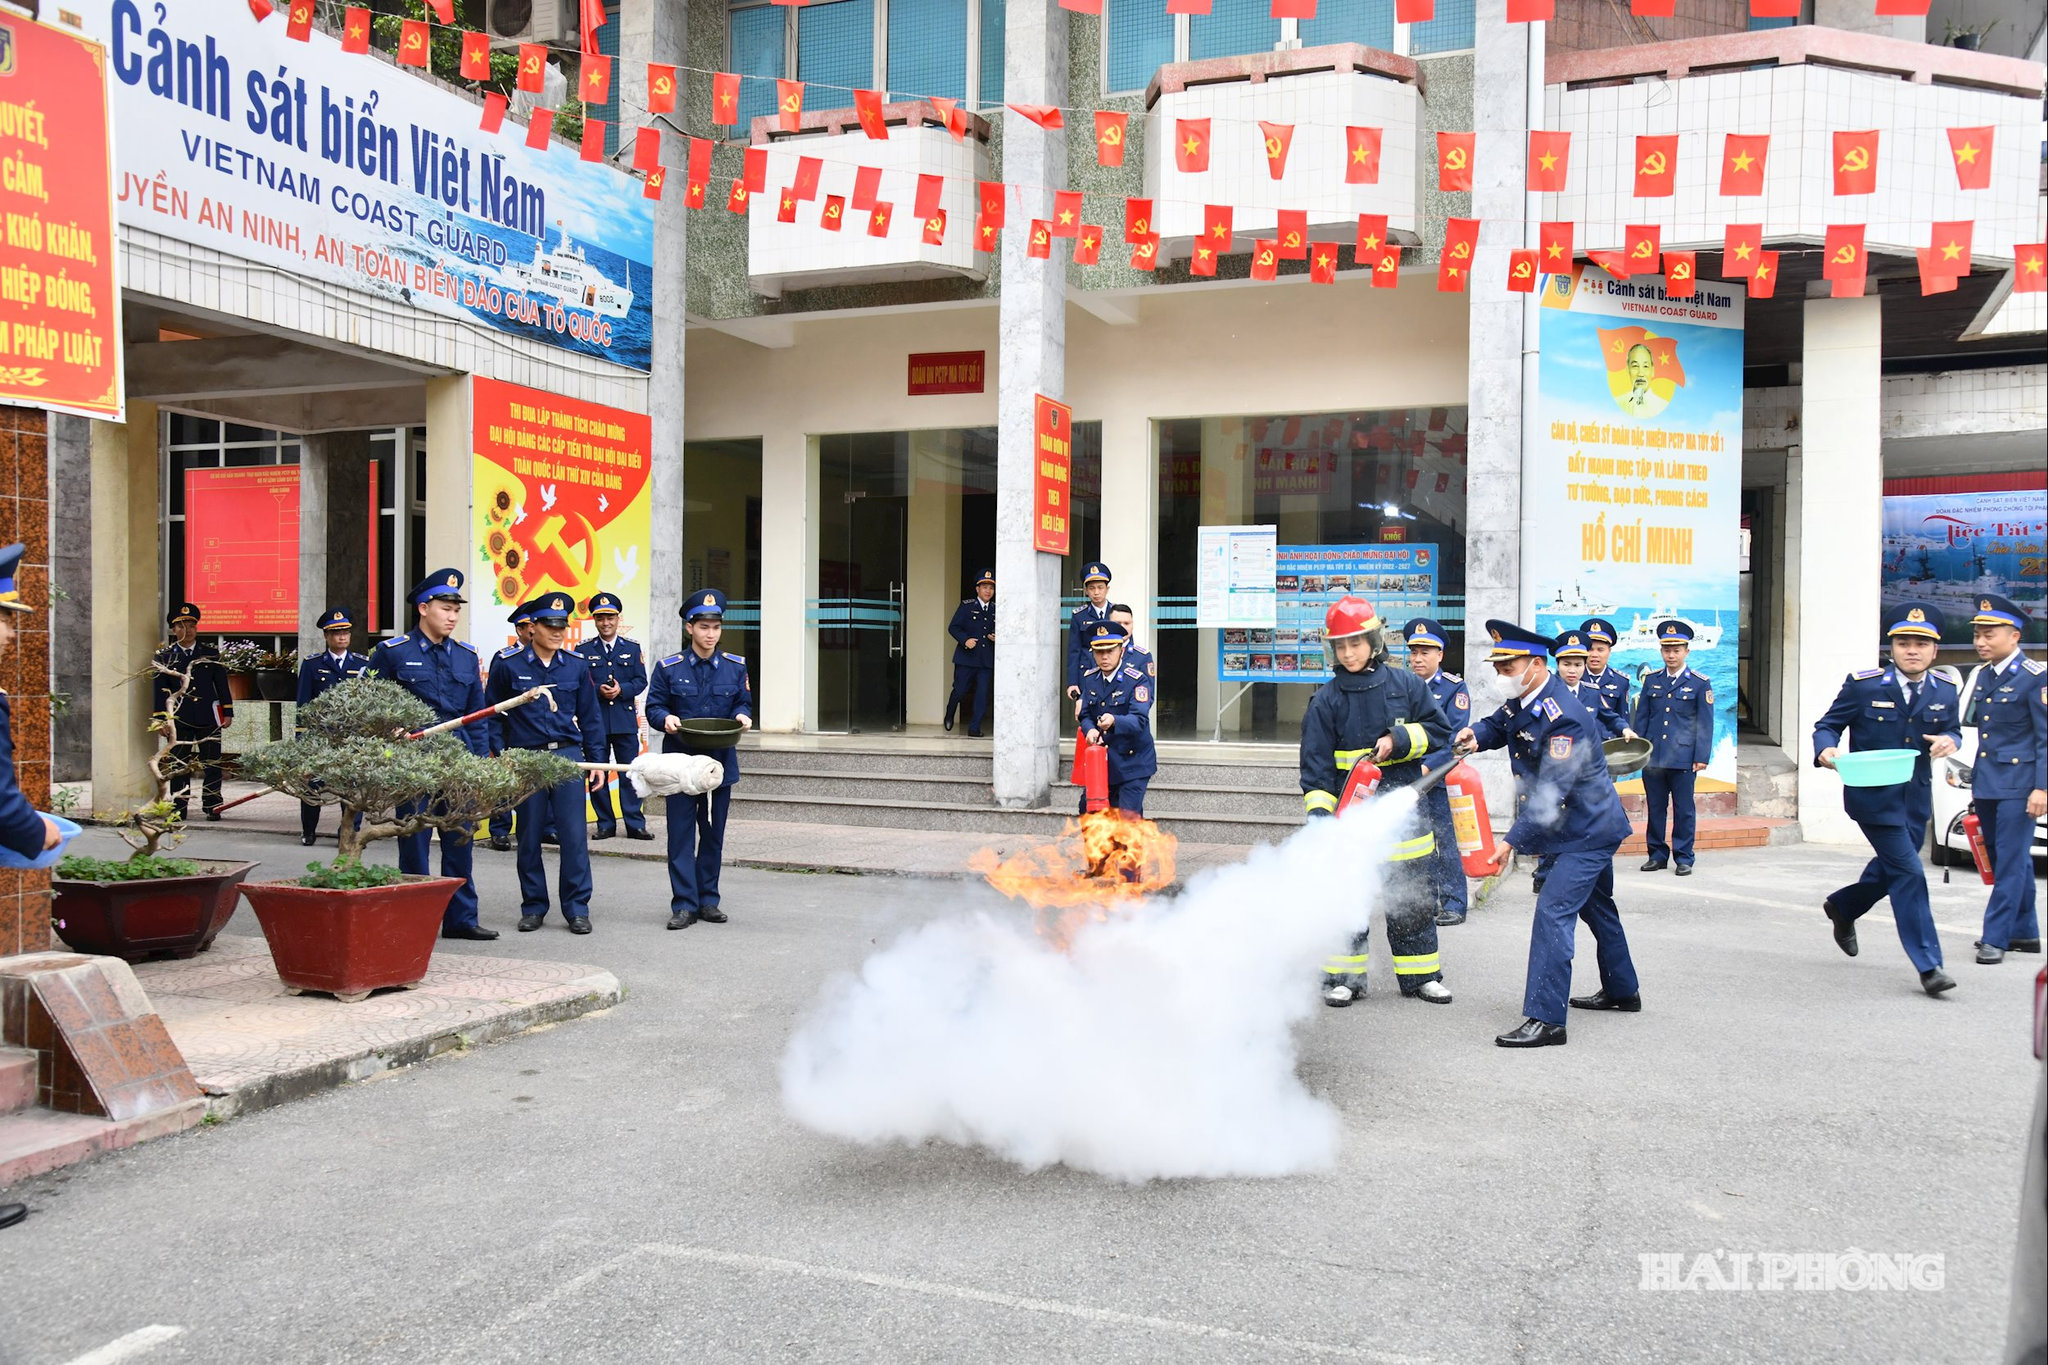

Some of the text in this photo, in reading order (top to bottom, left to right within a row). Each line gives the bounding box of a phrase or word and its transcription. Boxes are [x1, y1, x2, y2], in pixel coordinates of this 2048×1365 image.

[0, 99, 48, 150] UYẾT,
[111, 0, 545, 239] Cảnh sát biển Việt Nam
[3, 149, 49, 204] CẢM,
[181, 129, 508, 267] VIETNAM COAST GUARD
[7, 211, 43, 252] KHÓ
[46, 220, 97, 268] KHĂN,
[1, 263, 41, 310] HIỆP
[198, 197, 233, 234] AN
[243, 209, 307, 261] NINH,
[314, 234, 344, 267] AN
[351, 244, 407, 286] TOÀN
[414, 258, 458, 301] BIỂN
[463, 274, 501, 313] ĐẢO
[505, 288, 540, 327] CỦA
[543, 297, 565, 334] TỔ
[568, 311, 613, 347] QUỐC
[1621, 302, 1718, 320] VIETNAM COAST GUARD
[1638, 284, 1655, 300] sát
[1707, 292, 1731, 308] Nam
[13, 319, 59, 361] PHÁP
[63, 328, 103, 374] LUẬT
[509, 402, 626, 442] THI ĐUA LẬP THÀNH TÍCH CHÀO MỪNG
[1551, 419, 1566, 441] CÁN
[1580, 421, 1601, 443] CHIẾN
[1611, 424, 1630, 446] ĐOÀN
[1631, 426, 1645, 450] ĐẶC
[1645, 428, 1667, 451] NHIỆM
[1668, 431, 1685, 450] PCTP
[1685, 432, 1697, 450] MA
[1710, 429, 1720, 453] SỐ
[489, 425, 503, 446] ĐẠI
[503, 426, 516, 449] HỘI
[517, 427, 537, 450] ĐẢNG
[537, 433, 551, 453] CÁC
[552, 434, 566, 455] CẤP
[566, 438, 582, 459] TIẾN
[593, 446, 605, 465] ĐẠI
[605, 446, 616, 468] HỘI
[616, 450, 628, 469] ĐẠI
[628, 448, 642, 469] BIỂU
[1588, 457, 1615, 478] MẠNH
[1616, 459, 1634, 479] HỌC
[1635, 457, 1652, 481] TẬP
[1654, 458, 1665, 479] VÀ
[1667, 460, 1685, 480] LÀM
[1687, 463, 1708, 482] THEO
[513, 456, 532, 476] TOÀN
[533, 457, 551, 479] QUỐC
[566, 465, 580, 484] THỨ
[580, 469, 591, 486] XIV
[591, 467, 605, 488] CỦA
[605, 470, 623, 491] ĐẢNG
[1567, 482, 1579, 501] TƯ
[1613, 487, 1632, 507] ĐẠO
[1633, 485, 1653, 507] ĐỨC,
[1655, 489, 1684, 507] PHONG
[1685, 488, 1708, 508] CÁCH
[1582, 511, 1693, 565] HỒ CHÍ MINH
[1991, 521, 2029, 537] Tất
